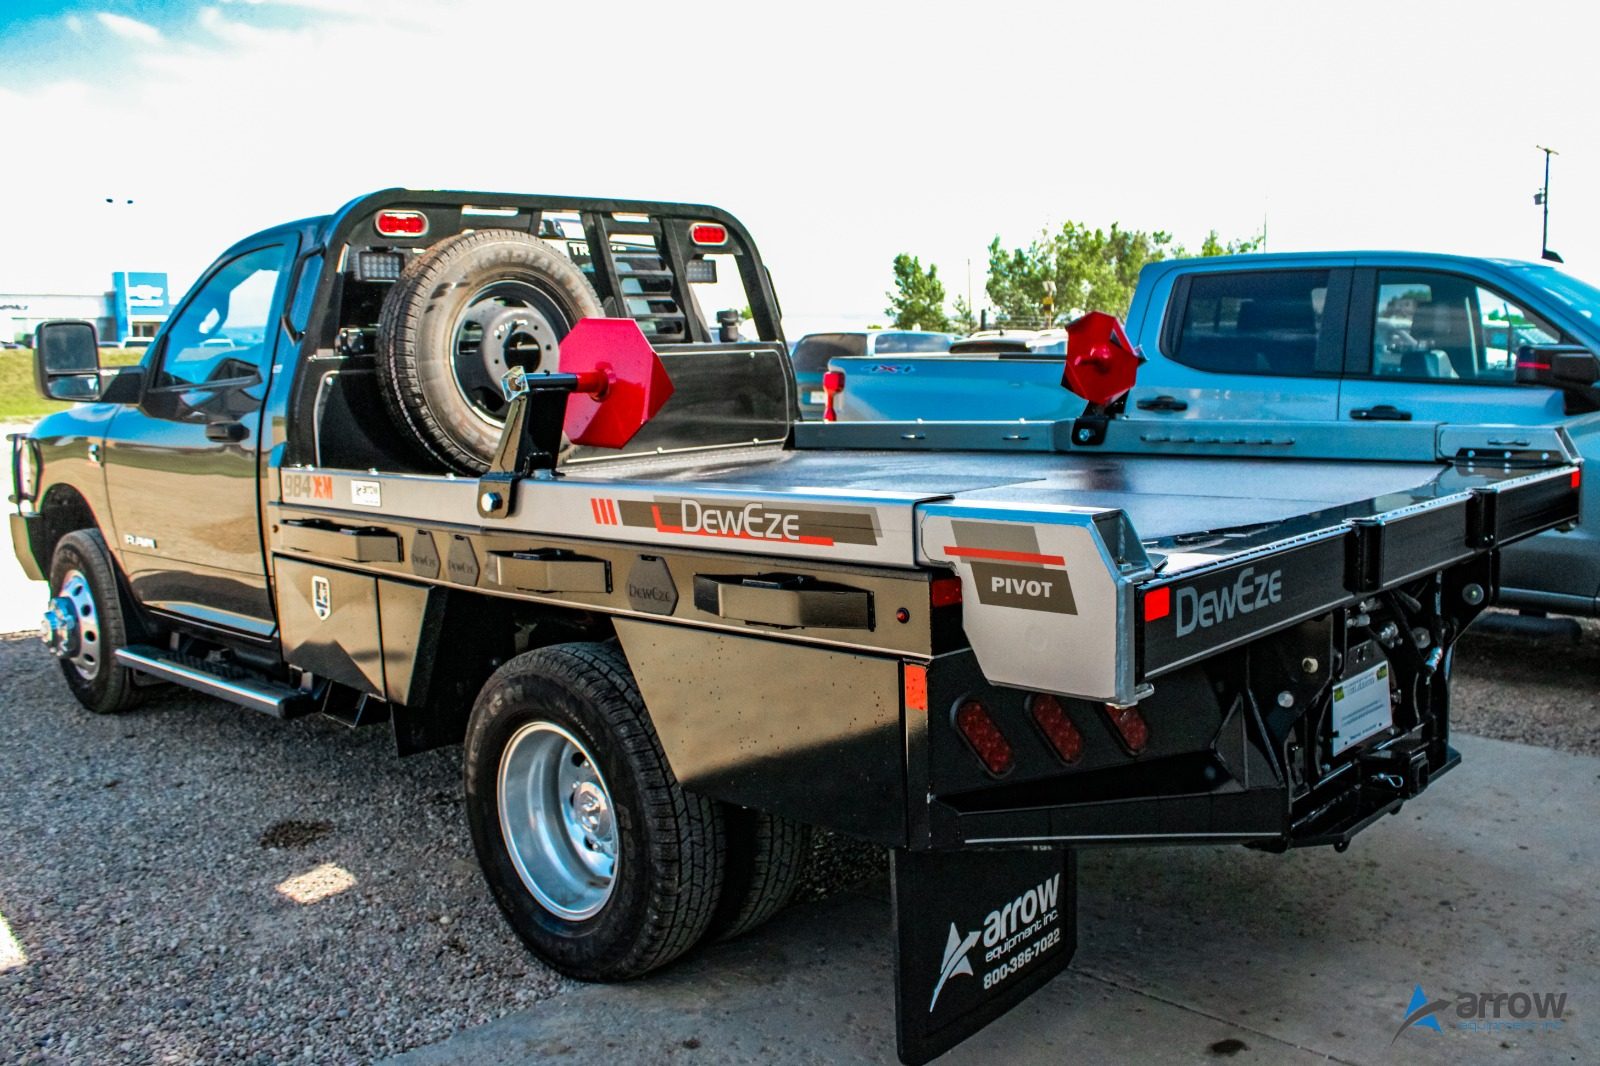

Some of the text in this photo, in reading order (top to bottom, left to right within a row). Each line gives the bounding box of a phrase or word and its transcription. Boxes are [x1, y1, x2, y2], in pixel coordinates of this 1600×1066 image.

[991, 576, 1053, 598] PIVOT
[983, 873, 1060, 948] arrow
[985, 920, 1042, 963] equipment
